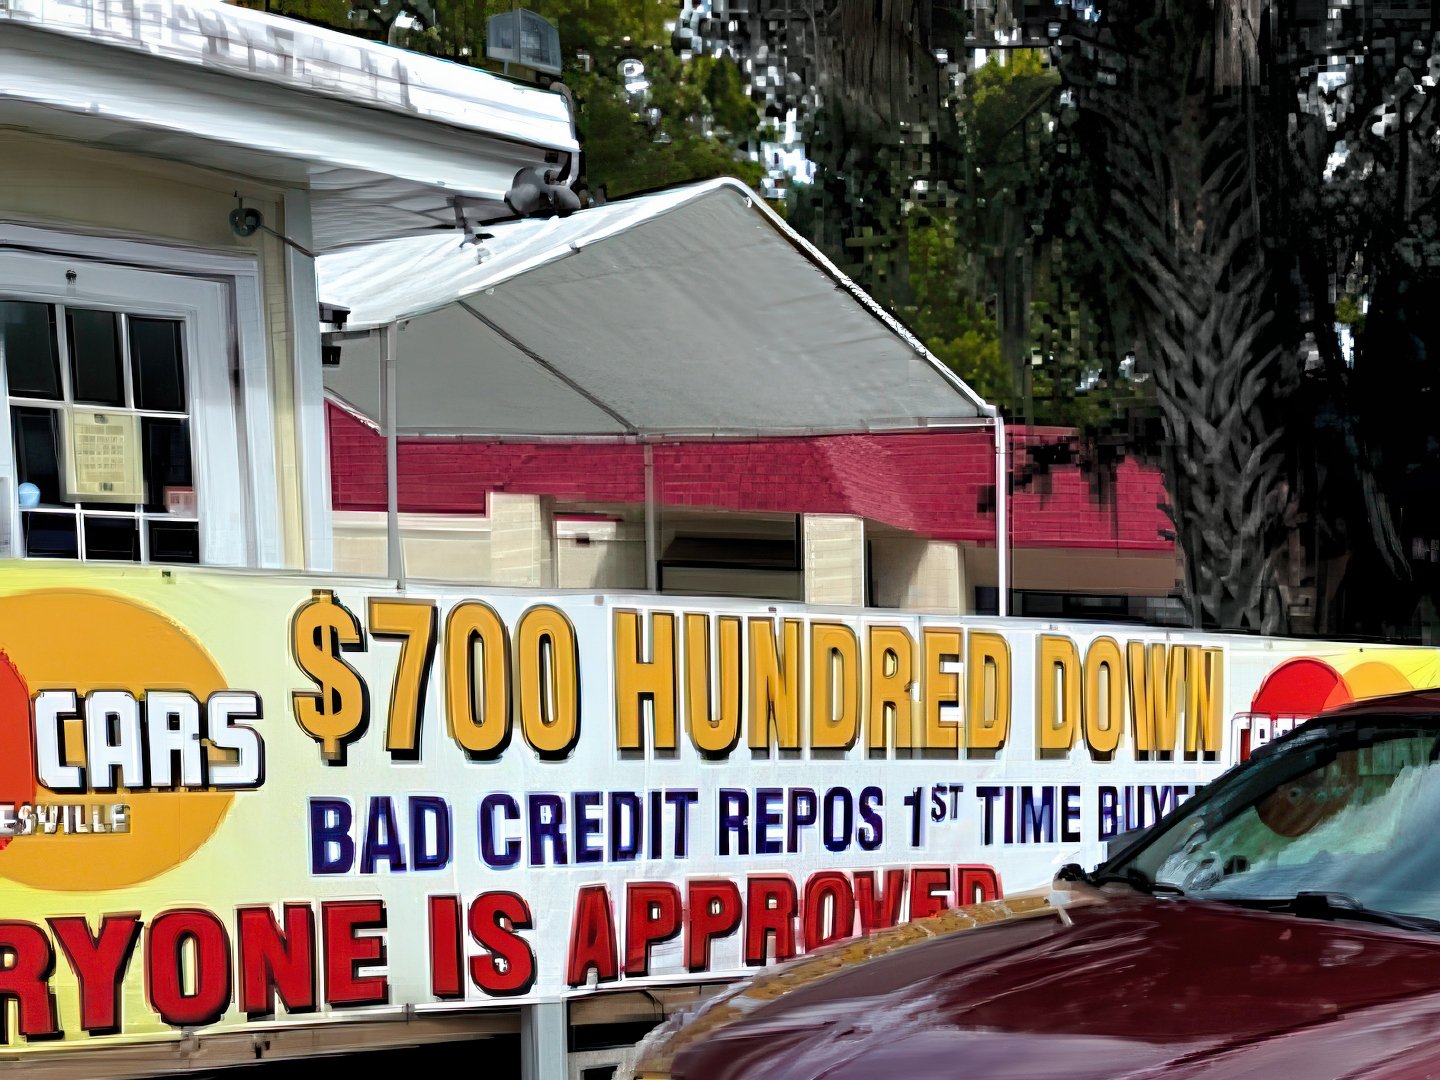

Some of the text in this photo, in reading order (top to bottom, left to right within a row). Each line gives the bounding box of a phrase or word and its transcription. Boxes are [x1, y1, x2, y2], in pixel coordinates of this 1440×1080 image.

[293, 590, 1223, 766] $700 HUNDRED DOWN
[34, 689, 265, 791] CARS
[1231, 712, 1309, 768] CA
[311, 797, 452, 874] BAD
[481, 790, 698, 868] CREDIT
[717, 787, 884, 855] REPOS
[976, 785, 1080, 846] TIME
[1098, 785, 1211, 842] BUY
[0, 898, 389, 1043] RYONE
[429, 892, 536, 998] IS
